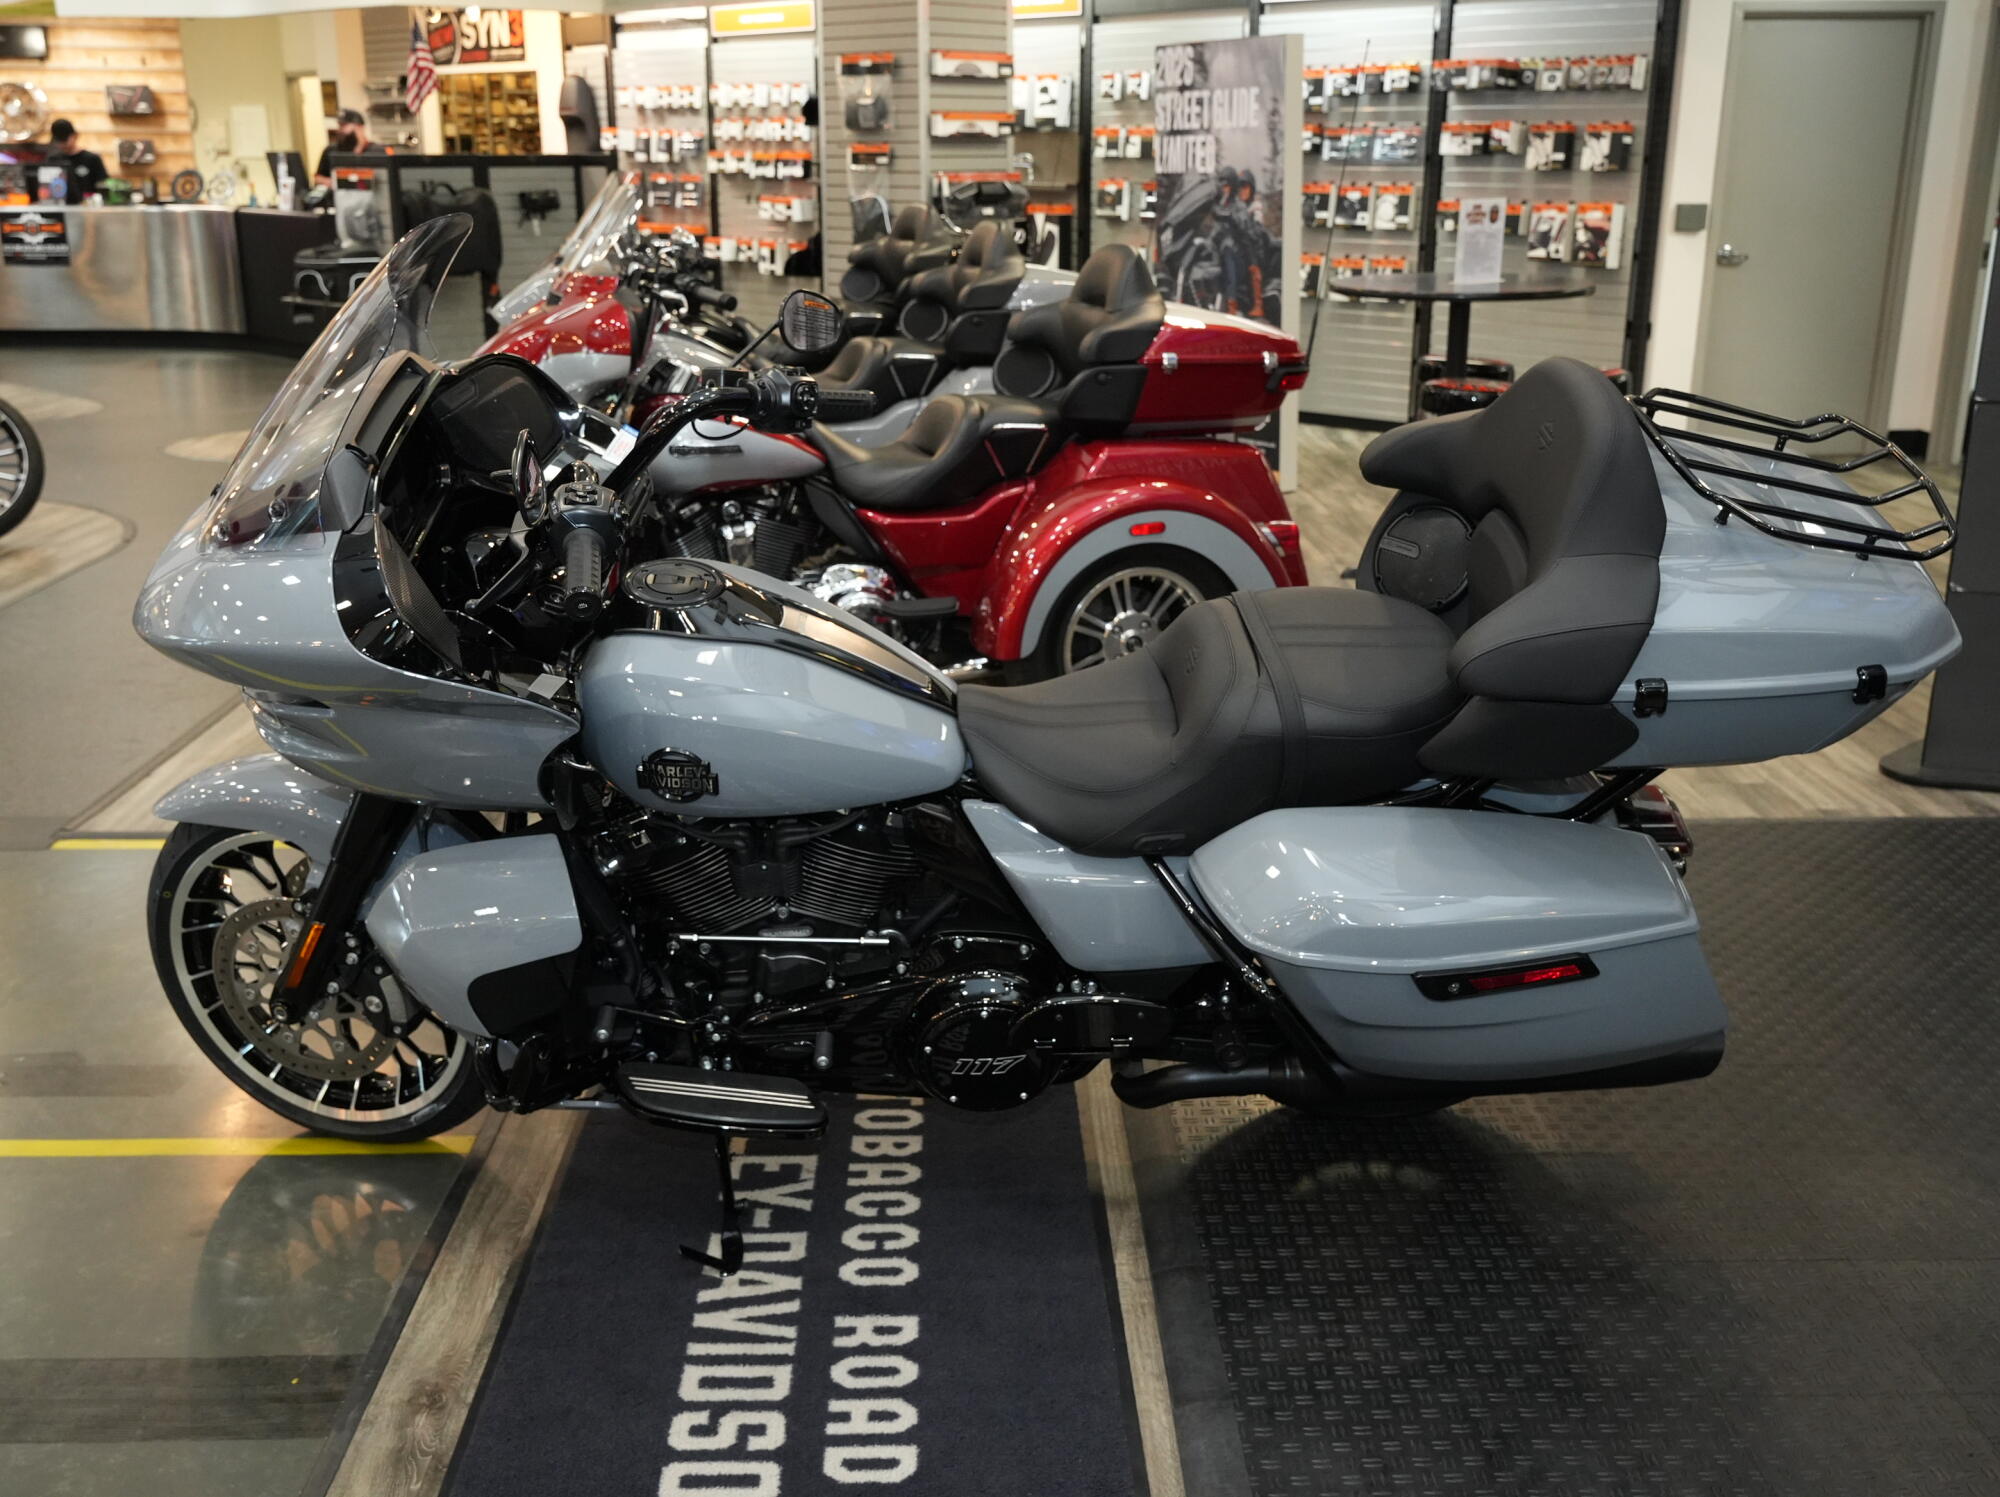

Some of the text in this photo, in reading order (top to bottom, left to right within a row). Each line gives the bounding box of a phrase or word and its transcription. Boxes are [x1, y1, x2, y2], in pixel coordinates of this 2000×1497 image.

[1155, 45, 1195, 88] 2025
[1154, 86, 1260, 132] STREET GLIDE
[1153, 133, 1217, 175] LIMITED
[951, 1054, 1027, 1076] 117
[822, 1314, 920, 1484] ROAD
